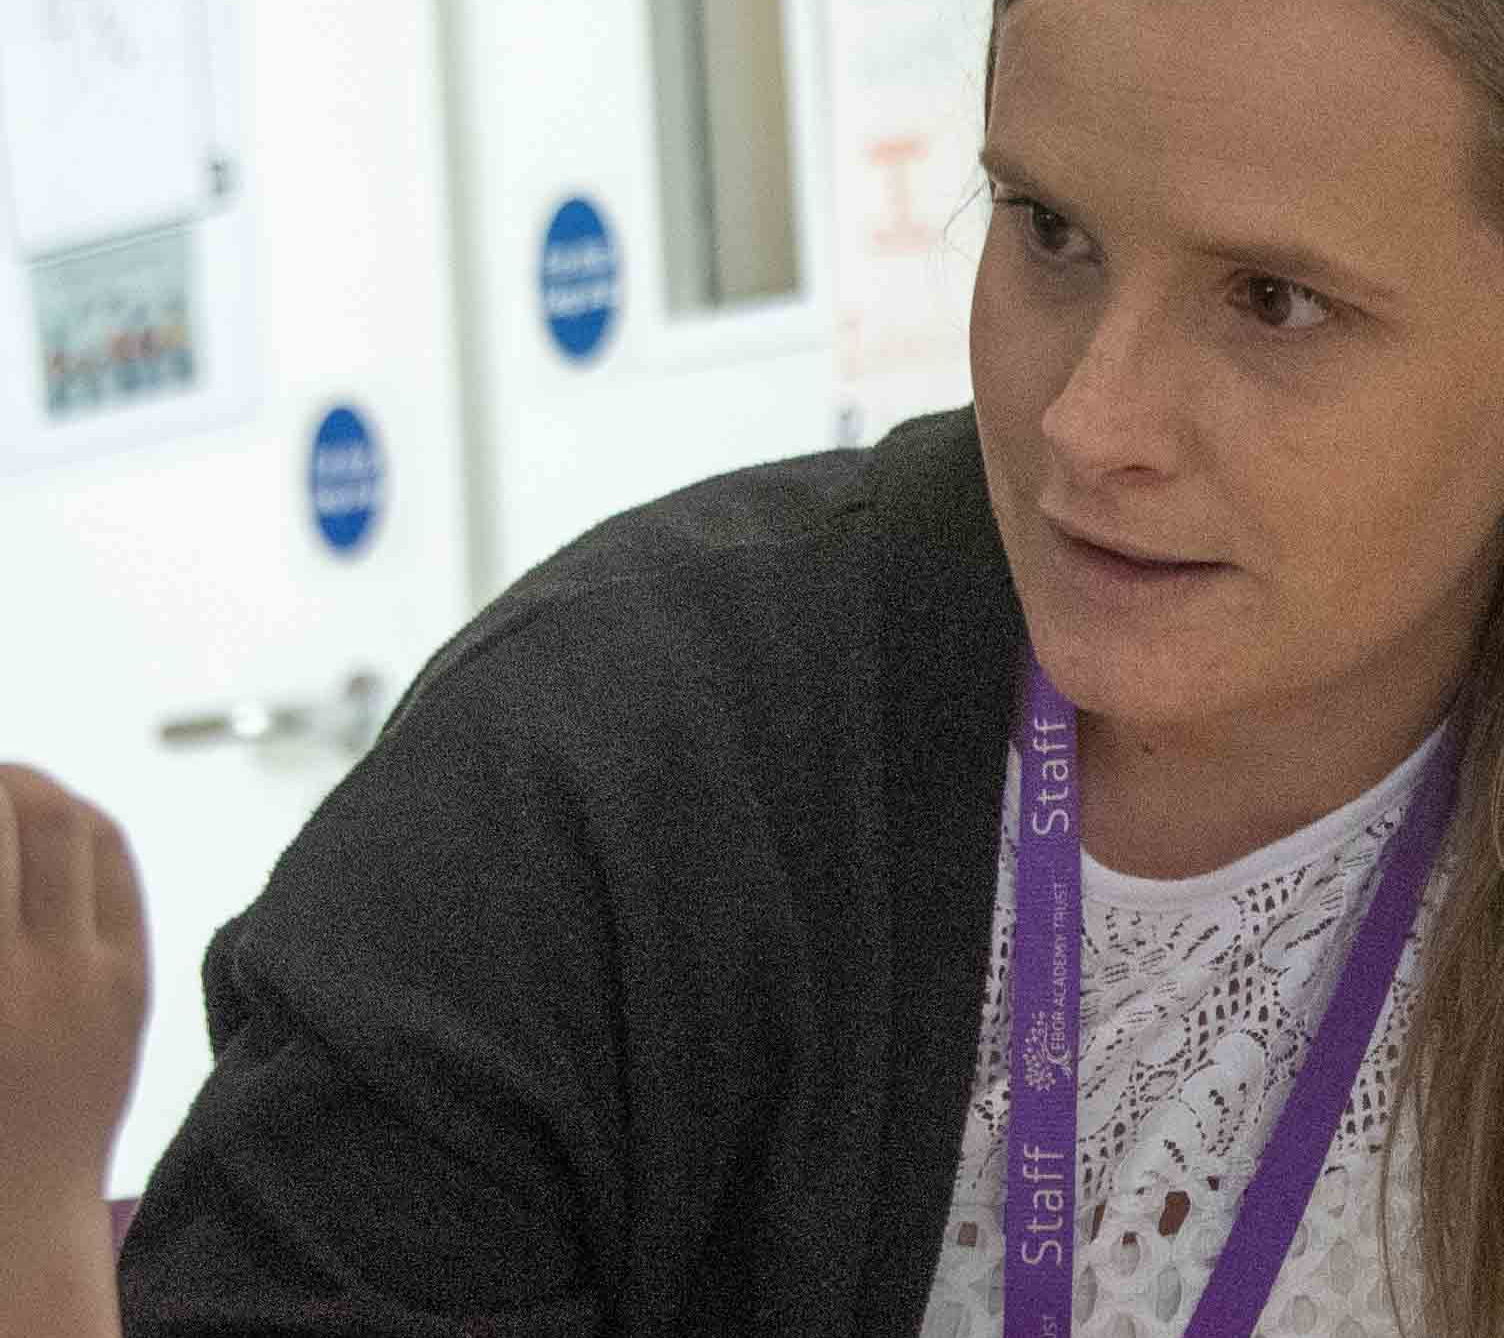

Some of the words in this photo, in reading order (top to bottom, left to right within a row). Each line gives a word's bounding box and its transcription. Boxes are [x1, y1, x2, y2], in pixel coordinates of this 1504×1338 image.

[1031, 716, 1070, 836] Staff
[1052, 881, 1068, 929] TRUST
[1052, 933, 1068, 1008] ACADEMY
[1050, 1010, 1066, 1051] EBOR
[1021, 1142, 1065, 1270] Staff
